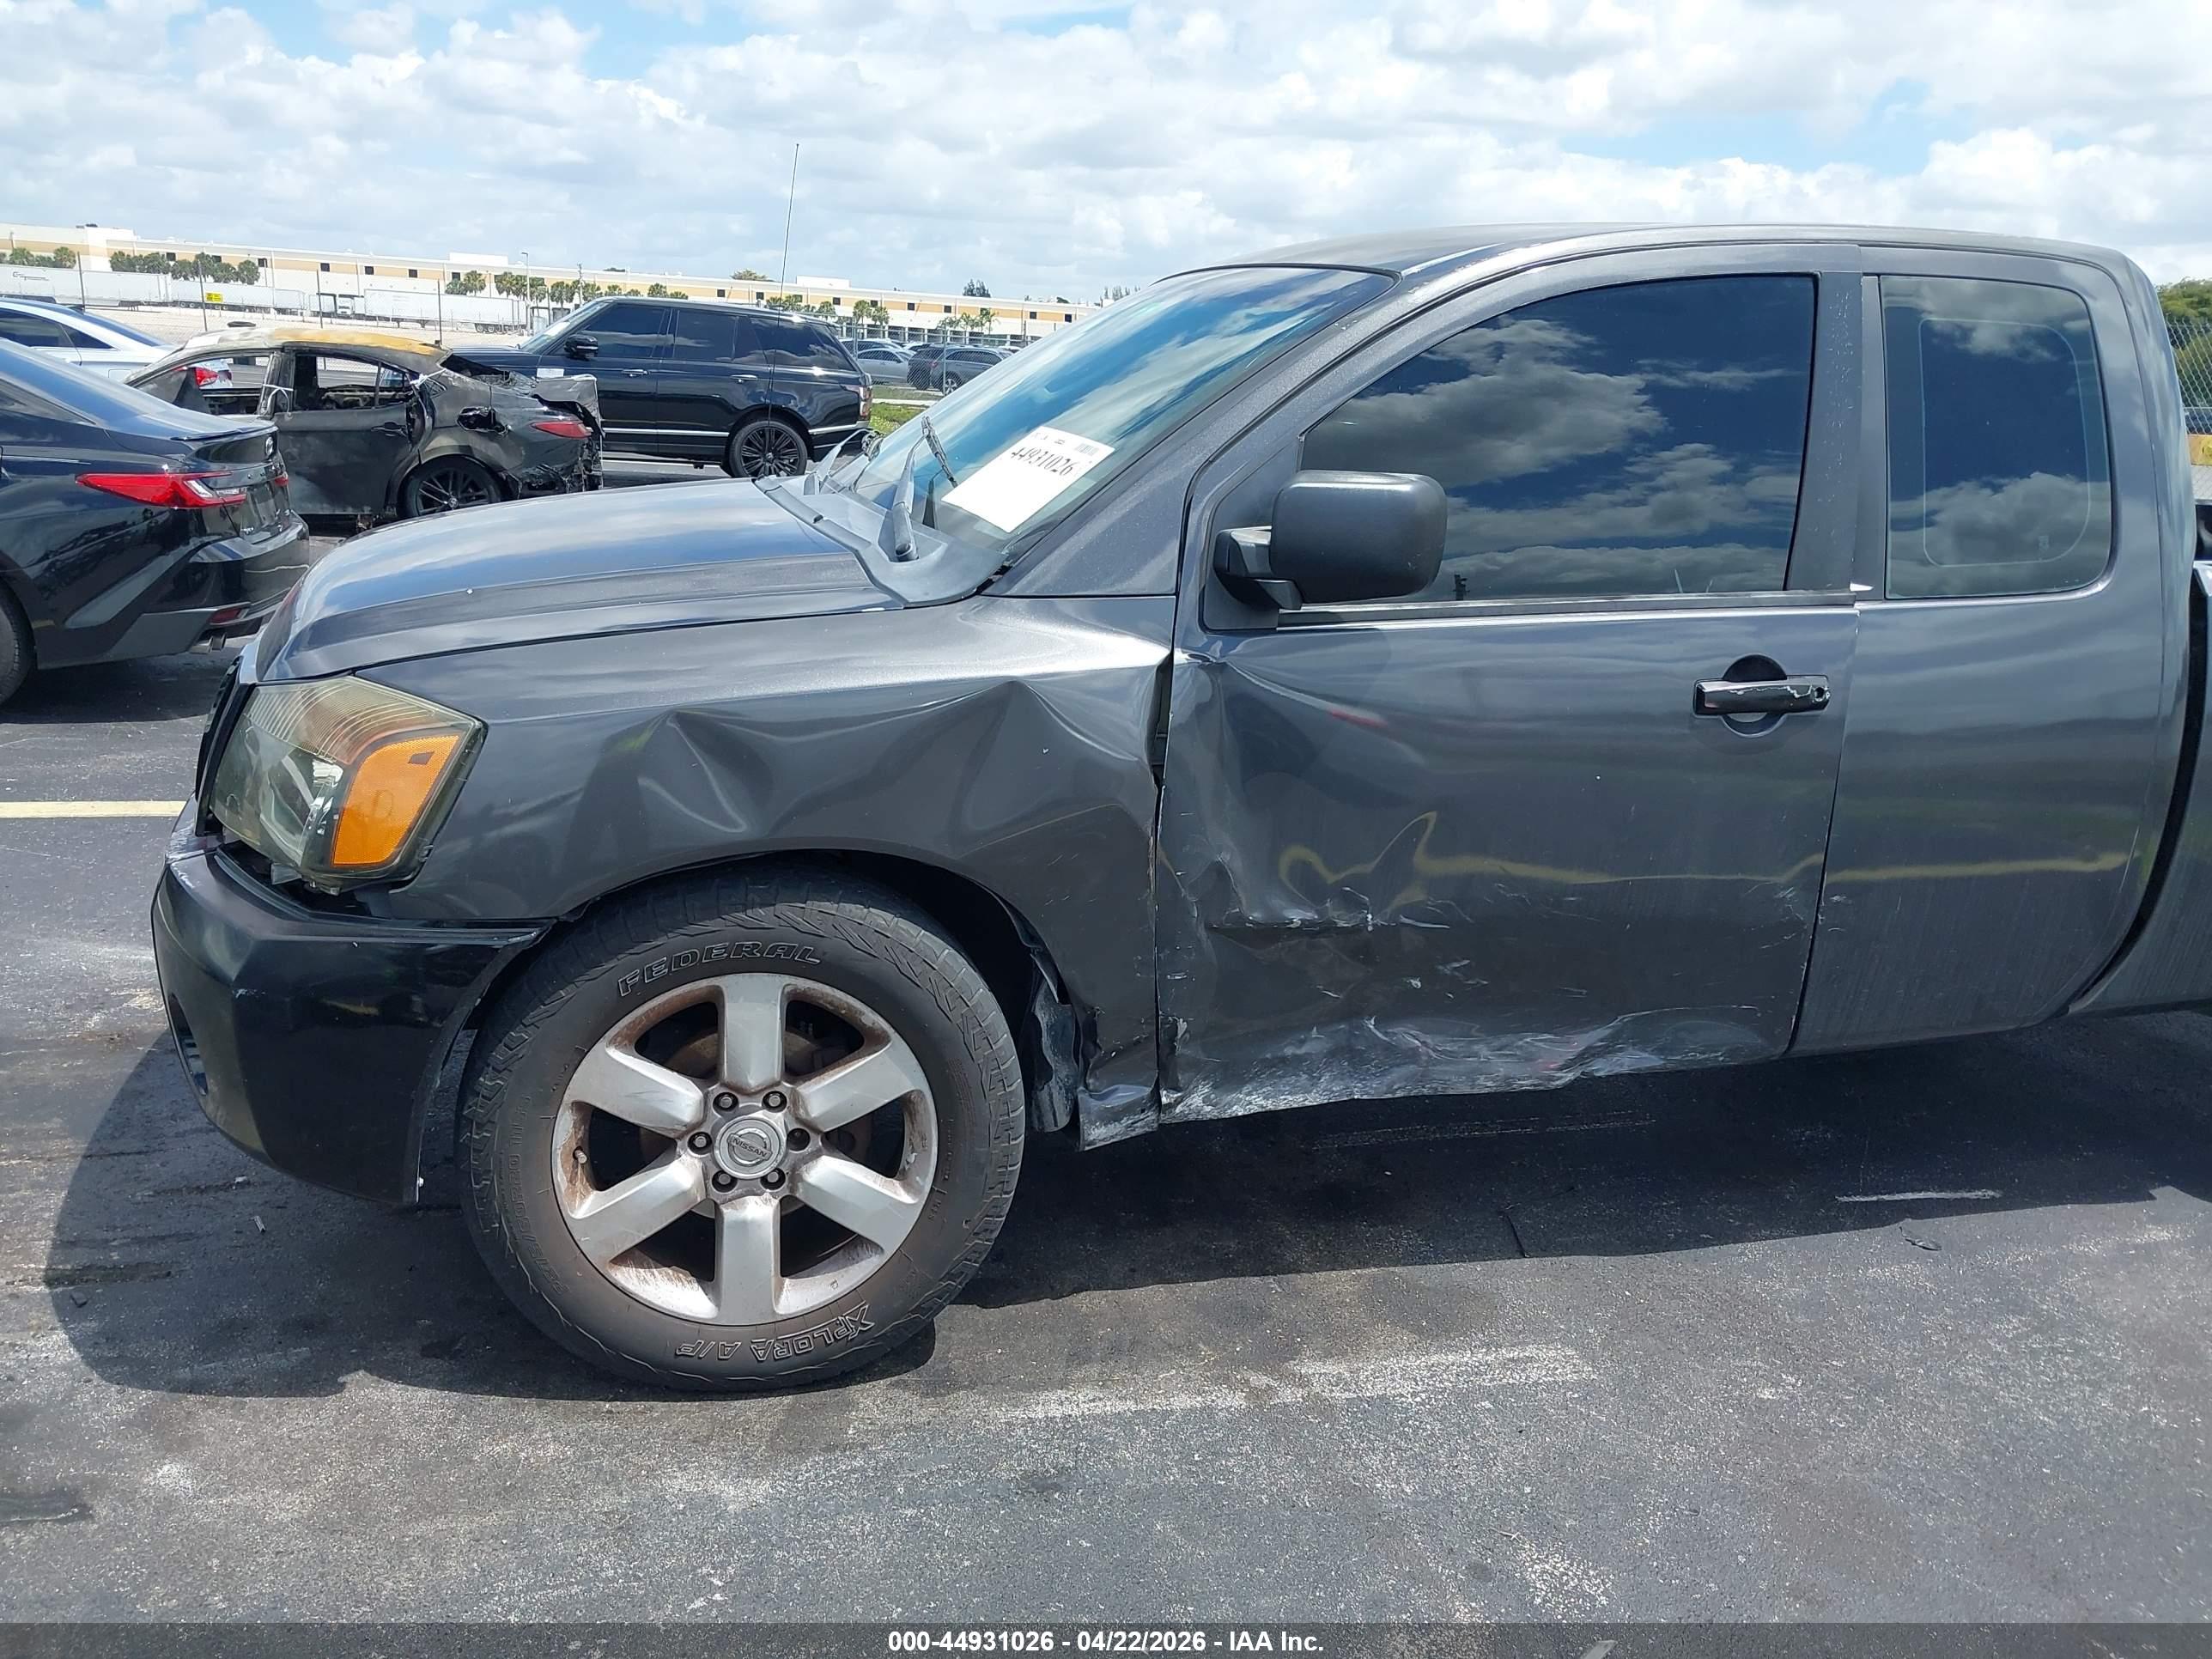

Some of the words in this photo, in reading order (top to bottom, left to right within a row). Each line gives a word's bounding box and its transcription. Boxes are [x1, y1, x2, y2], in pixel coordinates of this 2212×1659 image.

[618, 941, 821, 997] FEDERAL
[733, 1138, 767, 1157] NISSAN
[676, 1340, 741, 1360] A/P
[750, 1300, 875, 1362] XPLORA
